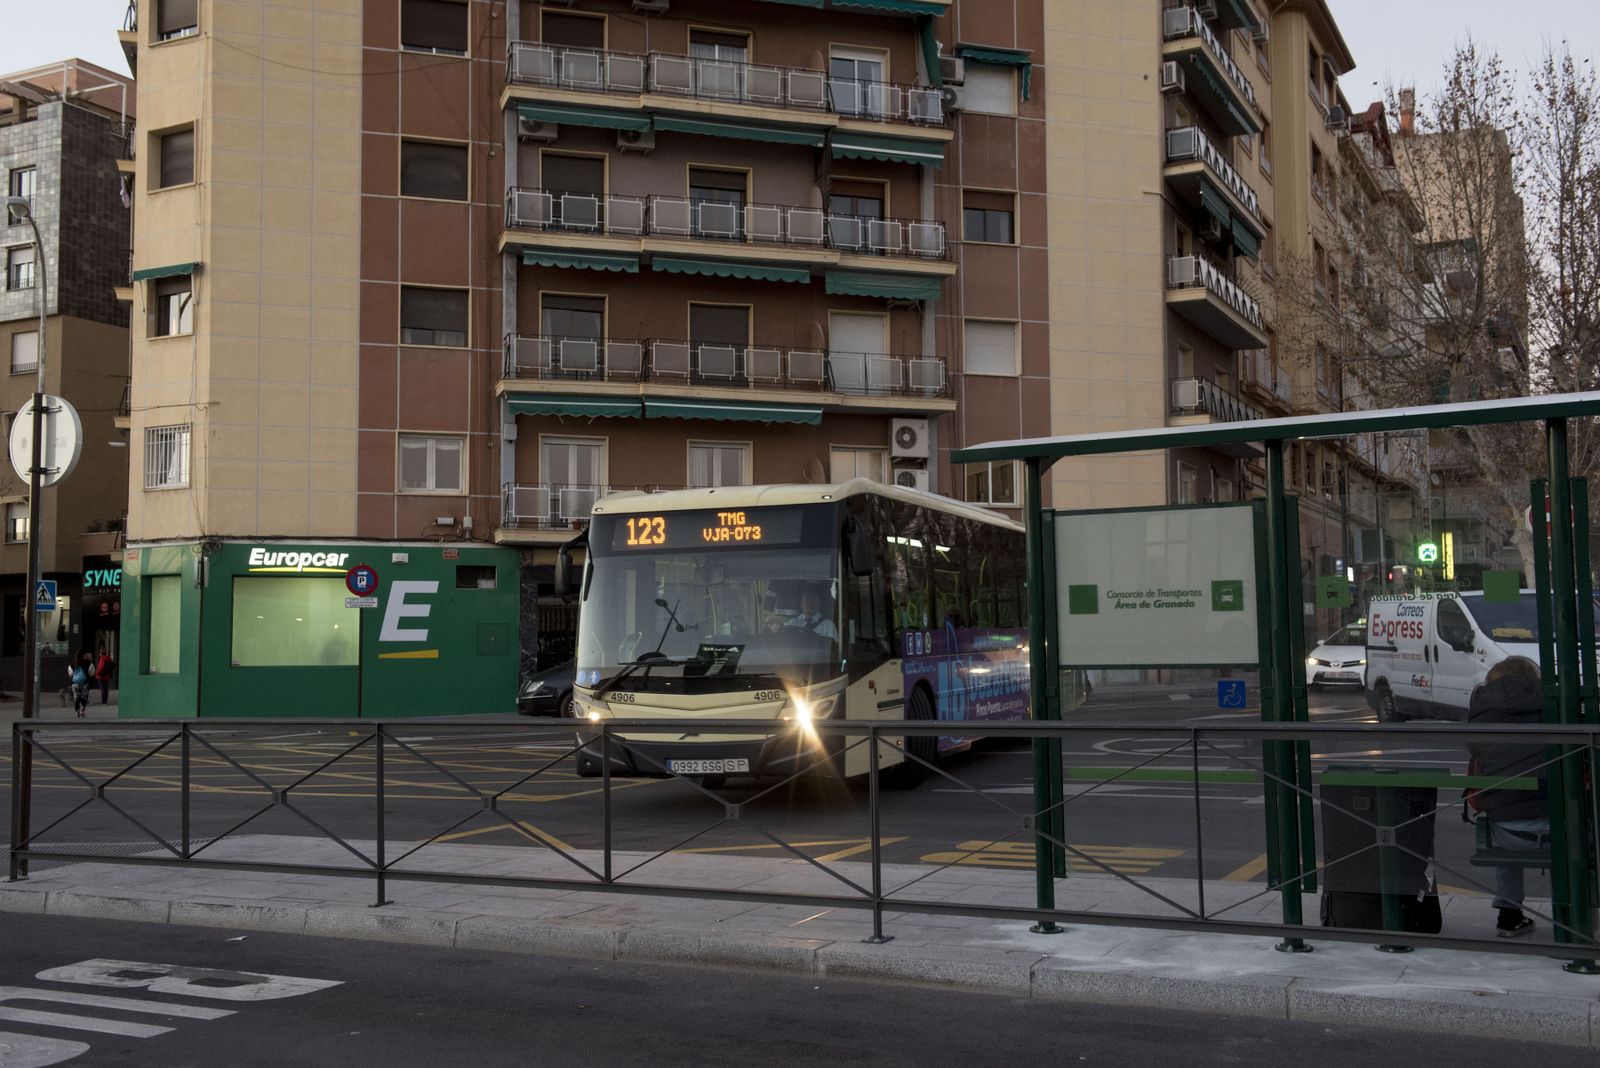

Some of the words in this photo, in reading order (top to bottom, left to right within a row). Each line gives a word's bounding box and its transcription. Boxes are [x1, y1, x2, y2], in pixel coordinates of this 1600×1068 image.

[717, 511, 746, 526] TMG
[626, 516, 666, 546] 123
[703, 526, 762, 542] VJA-073
[248, 547, 350, 573] Europcar
[1106, 590, 1144, 599] Consorcio
[1145, 589, 1156, 598] de
[1157, 588, 1203, 599] Transportes
[378, 580, 440, 642] E
[1115, 599, 1137, 609] Área
[1139, 600, 1151, 609] de
[1153, 599, 1195, 609] Granada
[1396, 603, 1425, 617] Correos
[1372, 614, 1423, 640] Express
[611, 692, 635, 703] 4906
[753, 690, 781, 702] 4906
[673, 760, 698, 772] 0992
[702, 760, 722, 772] GSG
